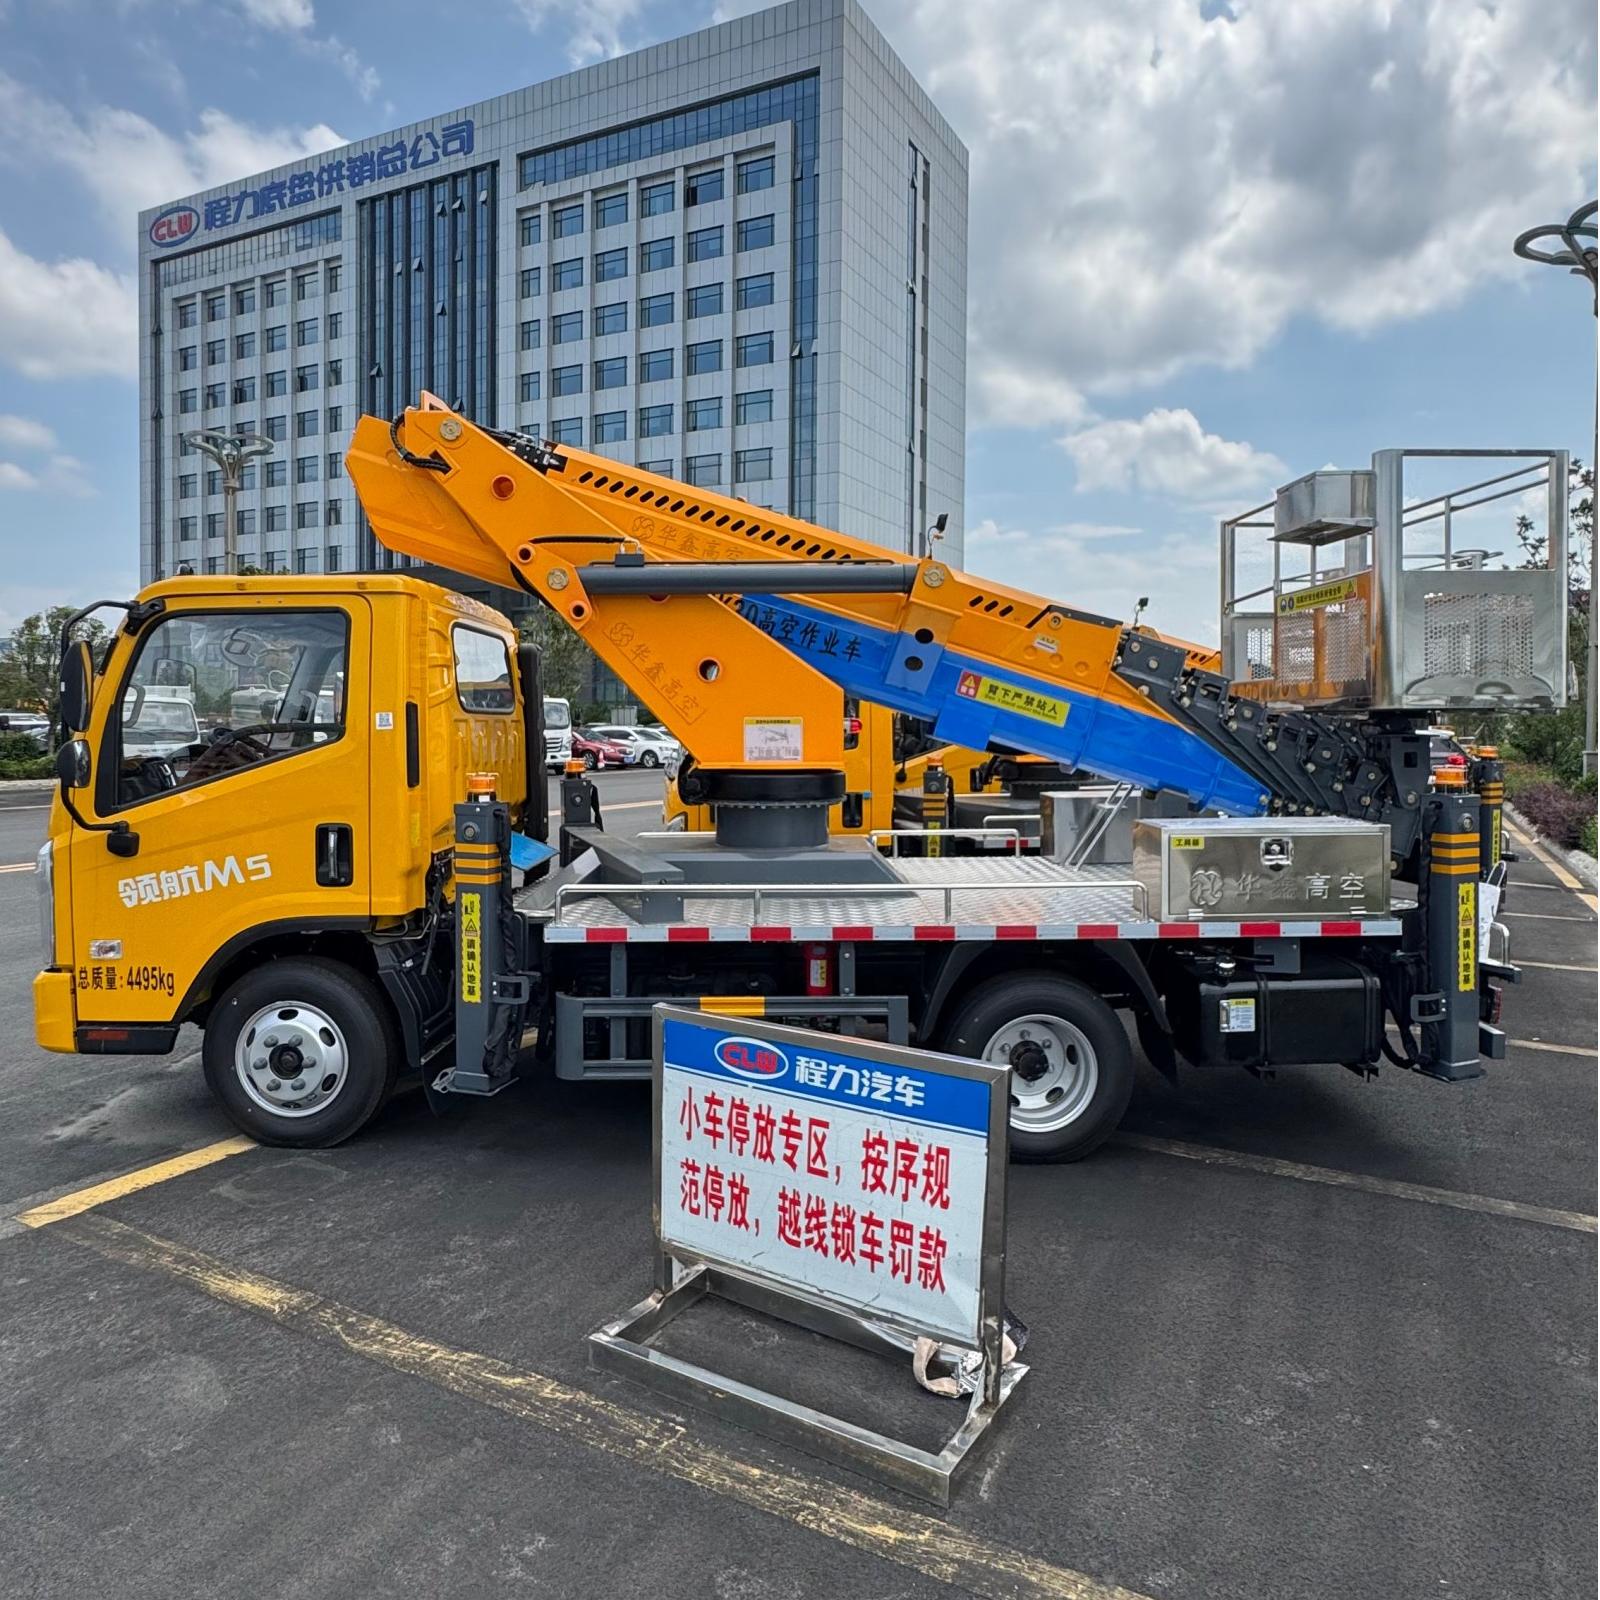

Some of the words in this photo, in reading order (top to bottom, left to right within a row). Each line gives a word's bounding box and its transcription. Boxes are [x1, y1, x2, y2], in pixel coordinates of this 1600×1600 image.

[152, 213, 193, 241] CLW
[203, 119, 475, 231] 程力底盘供销总公司
[118, 854, 272, 908] 领航M5
[722, 1043, 779, 1075] CLW
[794, 1055, 926, 1108] 程力汽车
[679, 1085, 951, 1211] 小车停放专区，按序规
[679, 1157, 947, 1295] 范停放，越线锁车罚款
